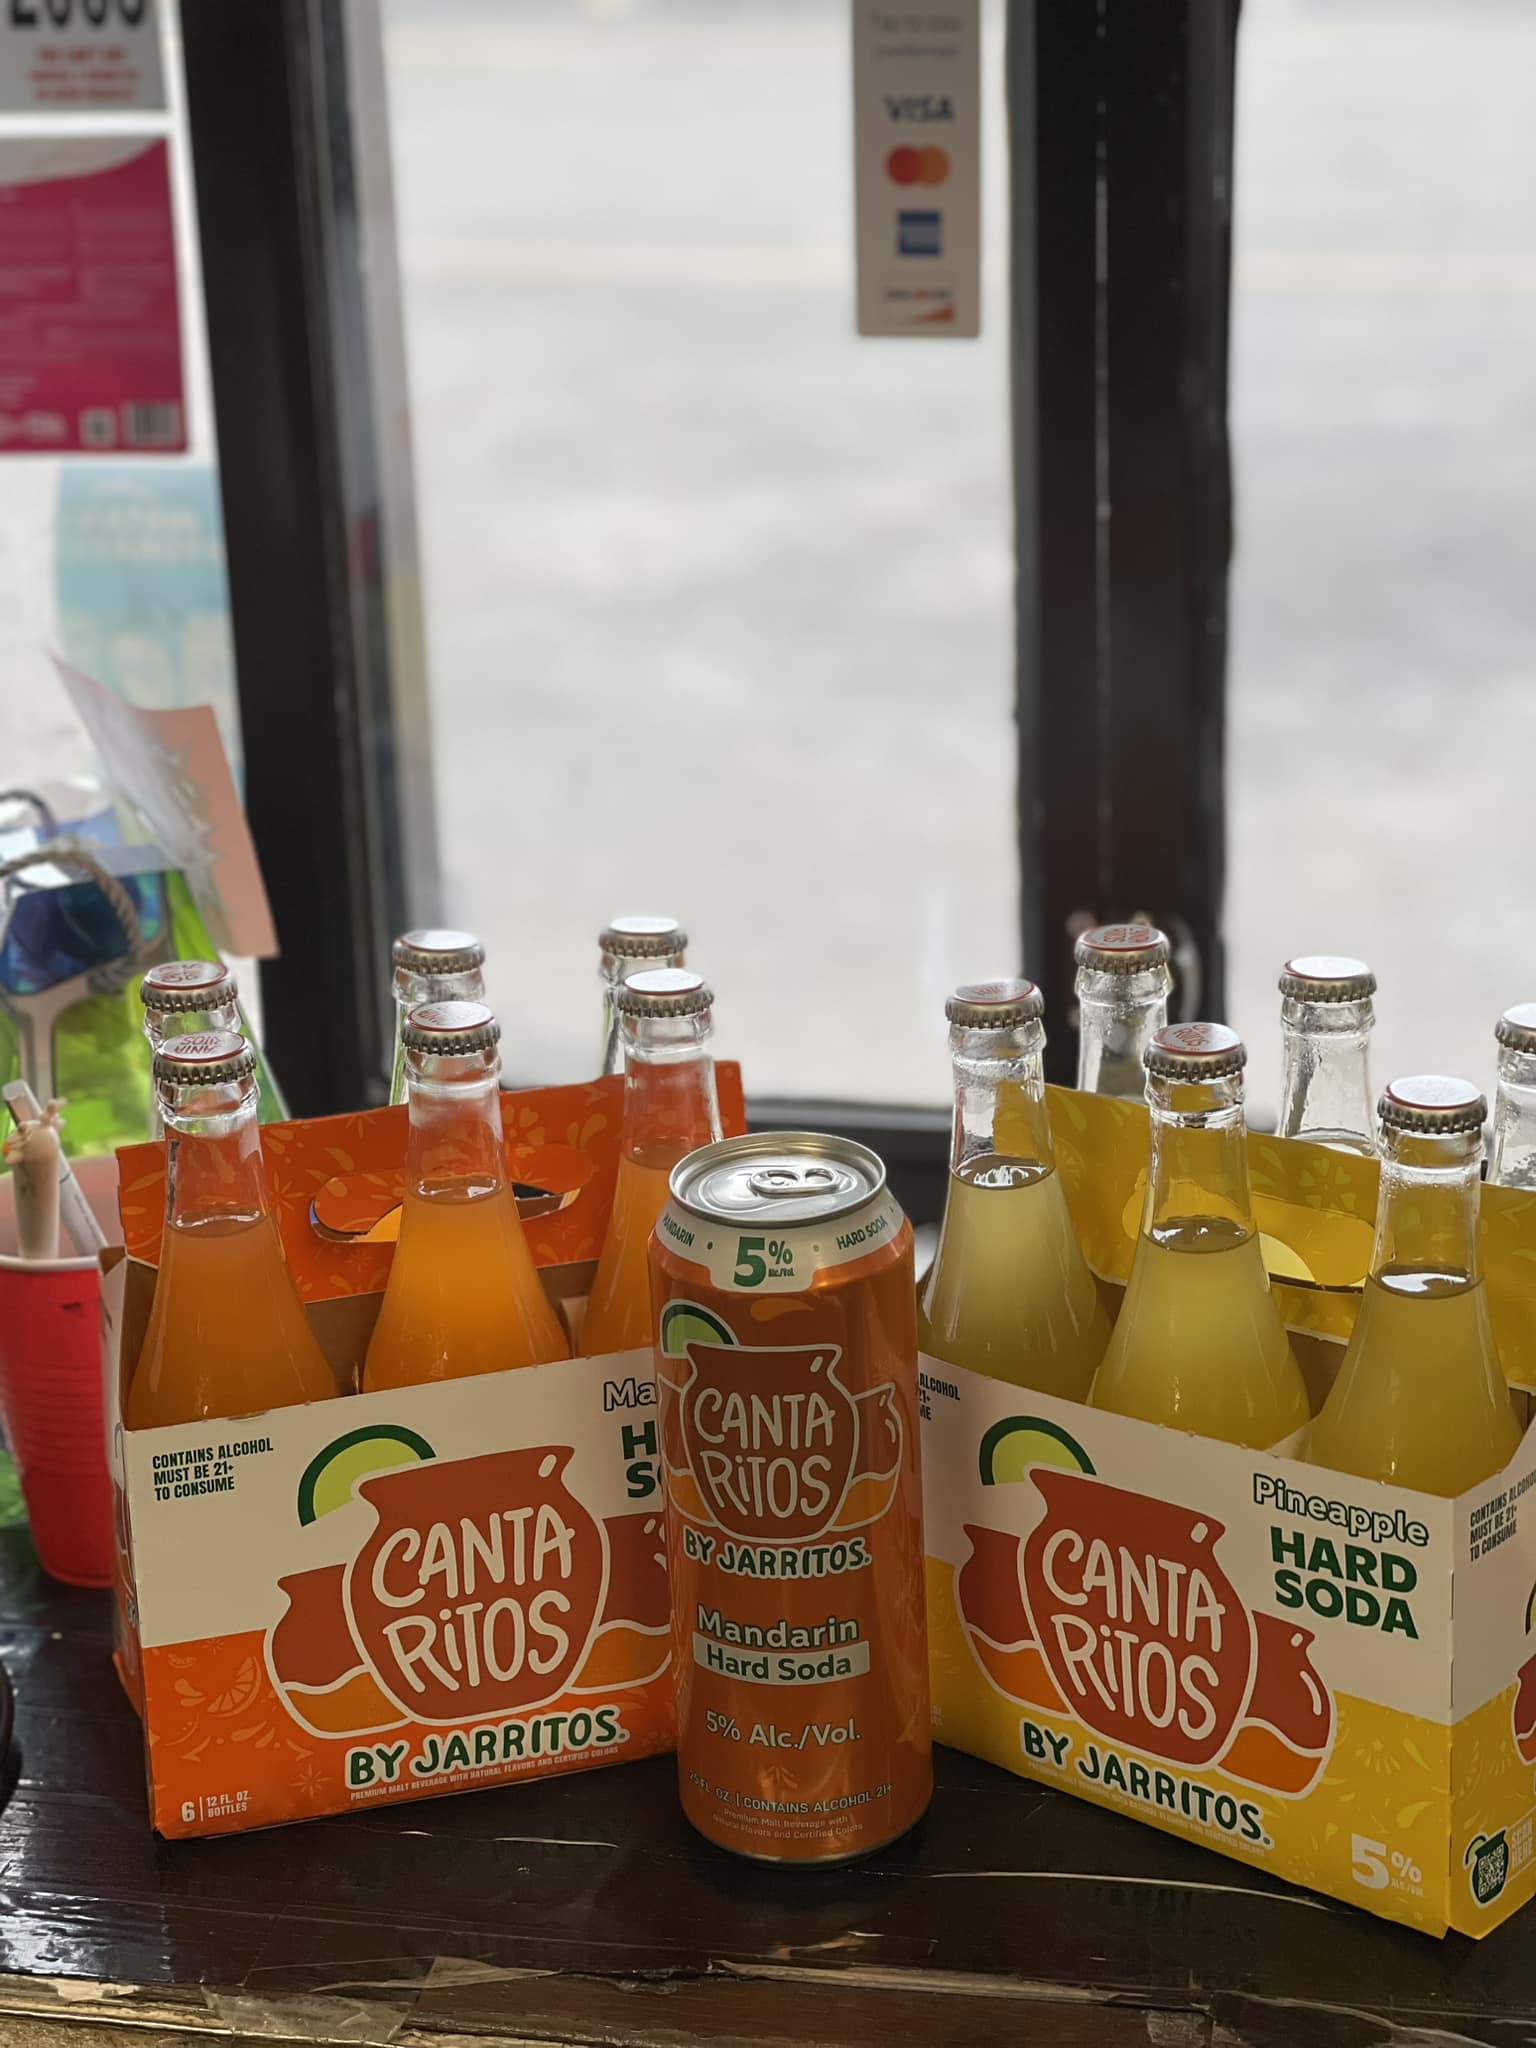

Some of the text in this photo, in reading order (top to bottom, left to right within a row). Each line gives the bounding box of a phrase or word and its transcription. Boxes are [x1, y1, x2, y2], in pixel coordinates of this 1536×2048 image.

[884, 95, 954, 122] VISA
[836, 1216, 889, 1250] HARD SODA
[693, 1387, 836, 1450] CANTA
[152, 1437, 274, 1469] CONTAINS ALCOHOL
[153, 1461, 234, 1486] MUST BE 21+
[155, 1476, 235, 1501] TO CONSUME
[1253, 1472, 1430, 1548] Pineapple
[1470, 1492, 1507, 1527] CONTAINS
[685, 1528, 714, 1562] BY
[1470, 1518, 1492, 1545] MUST
[1495, 1511, 1504, 1530] BE
[1470, 1519, 1517, 1562] TO CONSUME
[372, 1504, 576, 1608] CANTA
[1269, 1525, 1419, 1594] HARD
[1042, 1528, 1226, 1653] CANTA
[1275, 1569, 1420, 1640] SODA
[697, 1604, 858, 1649] Mandarin
[706, 1643, 852, 1681] Hard Soda
[705, 1709, 742, 1742] 5%
[1023, 1721, 1070, 1766] BY
[349, 1743, 406, 1786] BY
[351, 1786, 388, 1801] PREMIUM
[388, 1783, 409, 1794] MALT
[411, 1777, 449, 1791] BEVERAGE
[450, 1773, 469, 1783] WITH
[504, 1761, 536, 1774] FLAVORS
[181, 1801, 196, 1823] 6
[206, 1796, 217, 1807] 12
[207, 1802, 248, 1818] BOTTLES
[743, 1797, 809, 1814] CONTAINS
[813, 1792, 873, 1813] ALCOHOL
[829, 1815, 849, 1826] with
[1351, 1832, 1423, 1890] 5%
